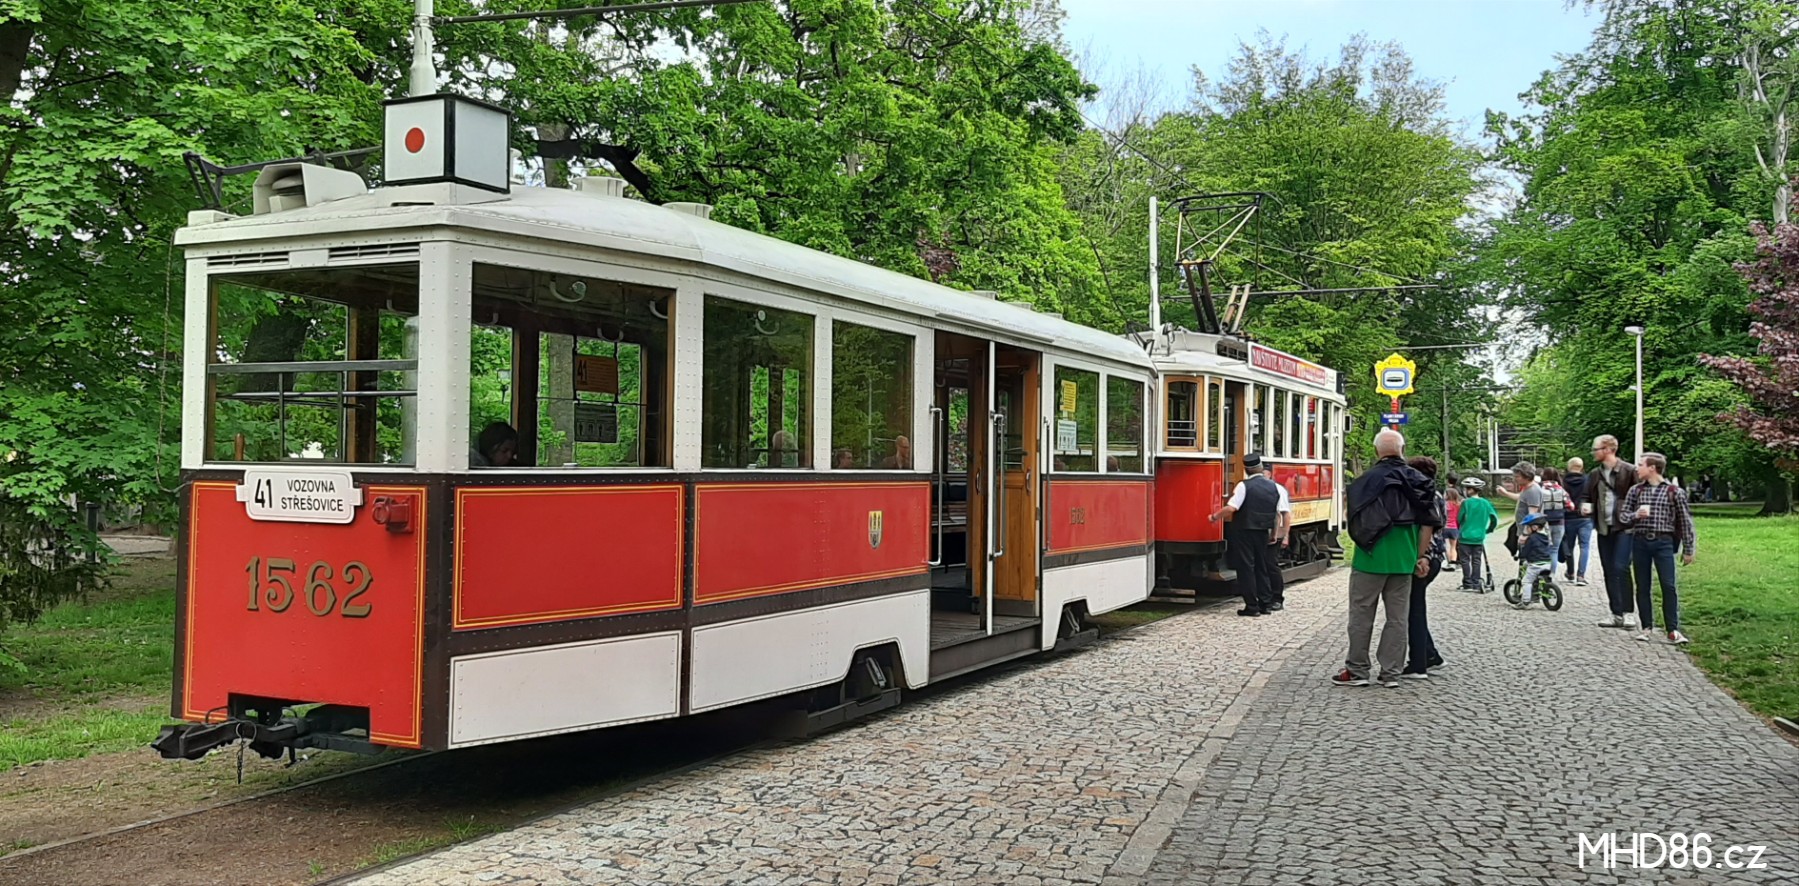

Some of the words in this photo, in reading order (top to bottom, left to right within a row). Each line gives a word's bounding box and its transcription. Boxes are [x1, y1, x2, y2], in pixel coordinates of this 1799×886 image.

[254, 478, 273, 509] 41
[286, 479, 336, 494] VOZOVNA
[281, 495, 344, 512] STŘEŠOVICE
[245, 555, 374, 618] 1562
